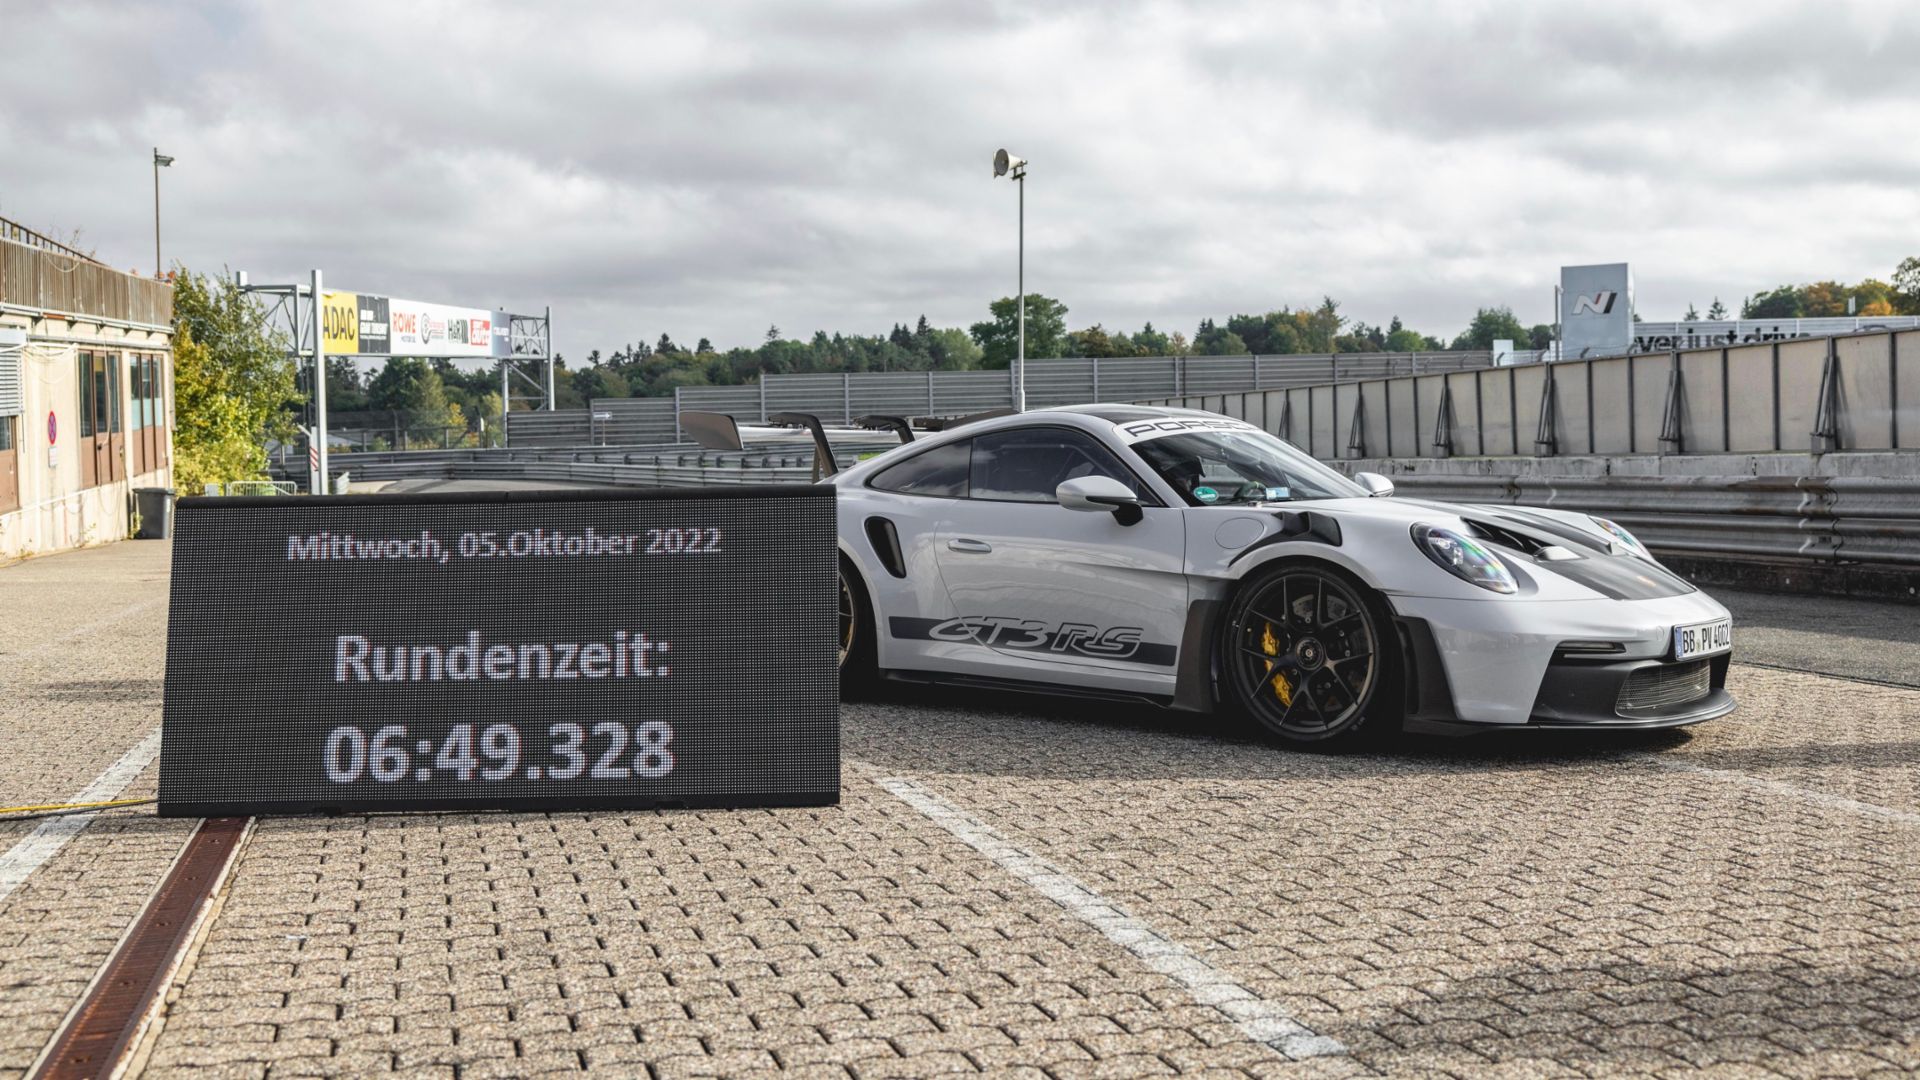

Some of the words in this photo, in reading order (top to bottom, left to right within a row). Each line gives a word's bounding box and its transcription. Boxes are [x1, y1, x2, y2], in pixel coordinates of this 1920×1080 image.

[322, 305, 355, 341] ADAC
[392, 312, 416, 334] ROWE
[1632, 334, 1683, 353] ver
[1124, 420, 1259, 437] PORSC
[286, 531, 449, 564] Mittwoch,
[459, 527, 637, 559] 05.Oktober
[646, 527, 723, 555] 2022
[1683, 630, 1695, 653] BB
[1702, 627, 1712, 650] PV
[1714, 624, 1729, 648] 4002
[334, 630, 670, 682] Rundenzeit:
[324, 720, 676, 784] 06:49.328
